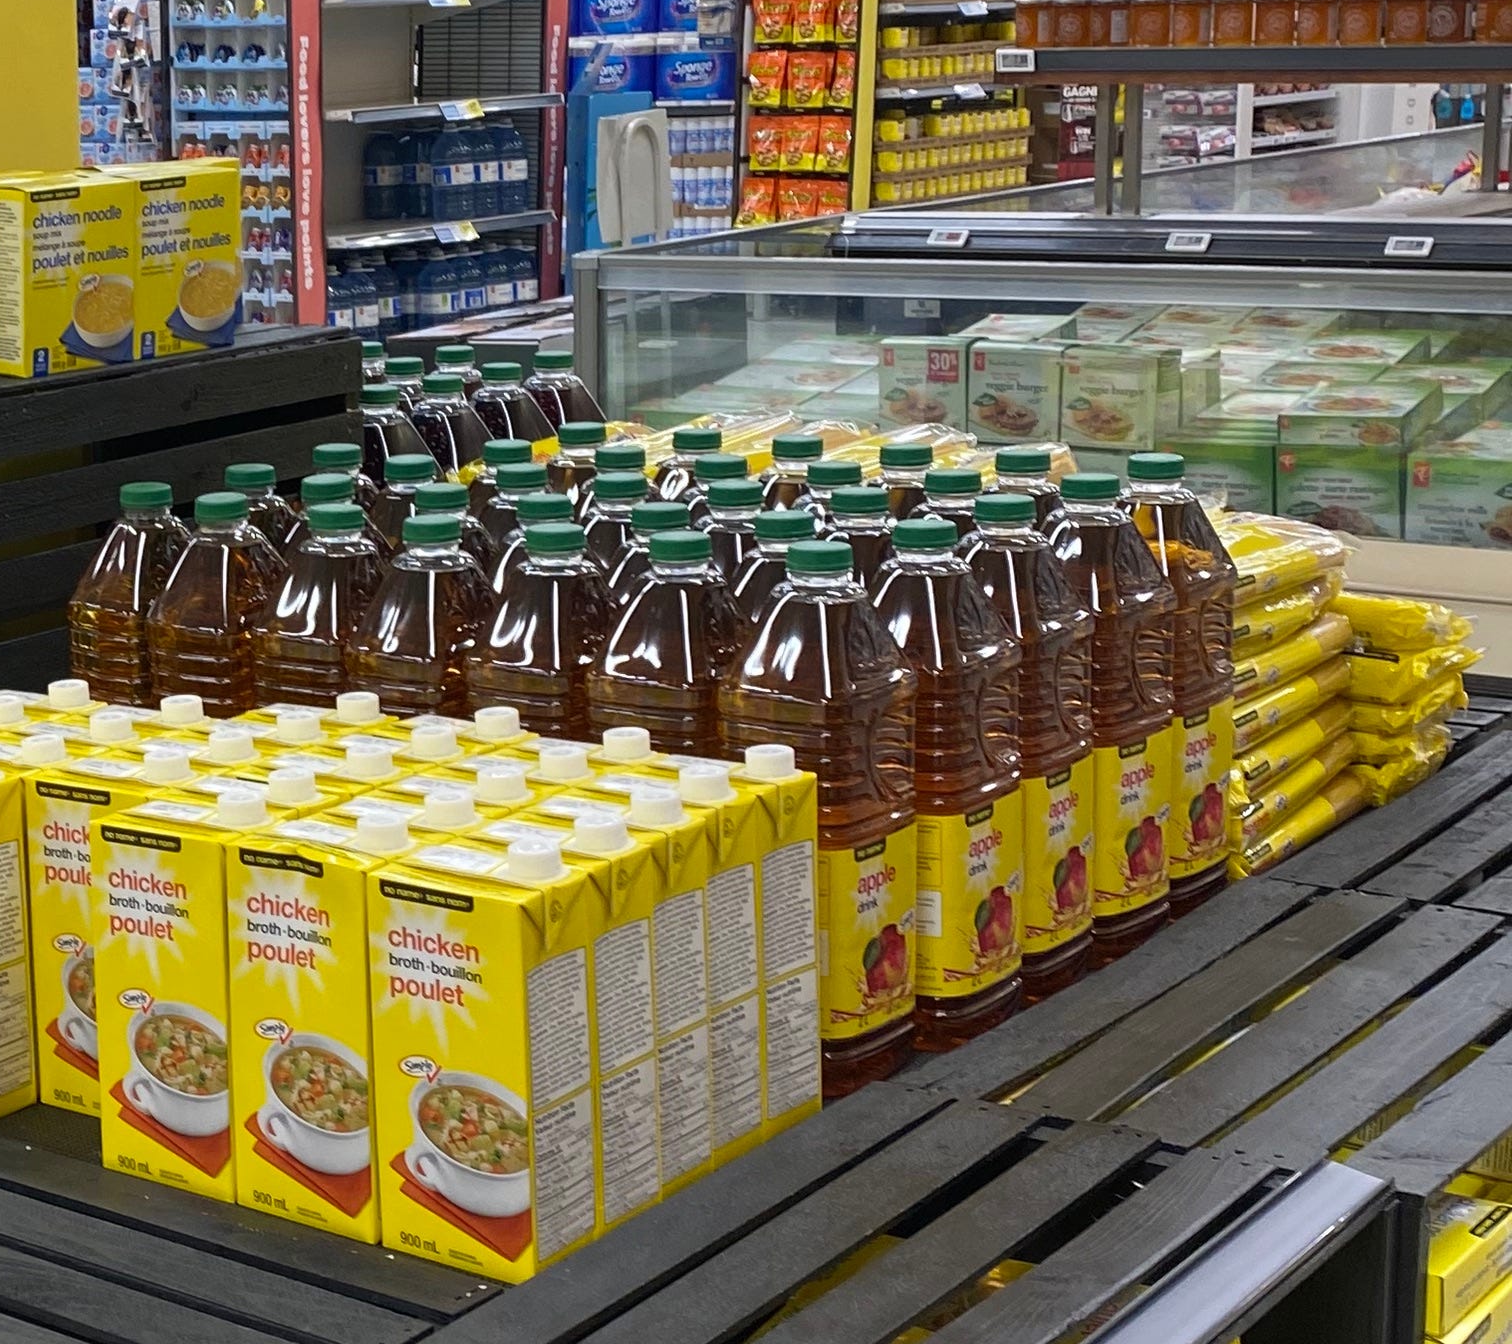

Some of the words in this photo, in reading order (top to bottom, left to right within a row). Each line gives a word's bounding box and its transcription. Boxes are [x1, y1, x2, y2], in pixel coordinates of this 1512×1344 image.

[298, 35, 310, 90] Food
[298, 94, 311, 165] lovers
[142, 197, 186, 217] chicken
[188, 194, 225, 212] noodle
[301, 169, 313, 216] love
[33, 209, 81, 229] chicken
[83, 205, 122, 223] noodle
[33, 251, 72, 273] poulet
[74, 251, 85, 265] et
[88, 245, 129, 264] nouilles
[142, 239, 178, 260] poulet
[180, 238, 191, 252] et
[968, 827, 1004, 861] apple
[108, 868, 189, 901] chicken
[856, 862, 897, 897] apple
[246, 893, 331, 928] chicken
[856, 897, 879, 915] drink
[109, 913, 175, 943] poulet
[247, 938, 318, 972] poulet
[388, 926, 480, 964] chicken
[390, 975, 465, 1007] poulet
[399, 1231, 422, 1252] 900
